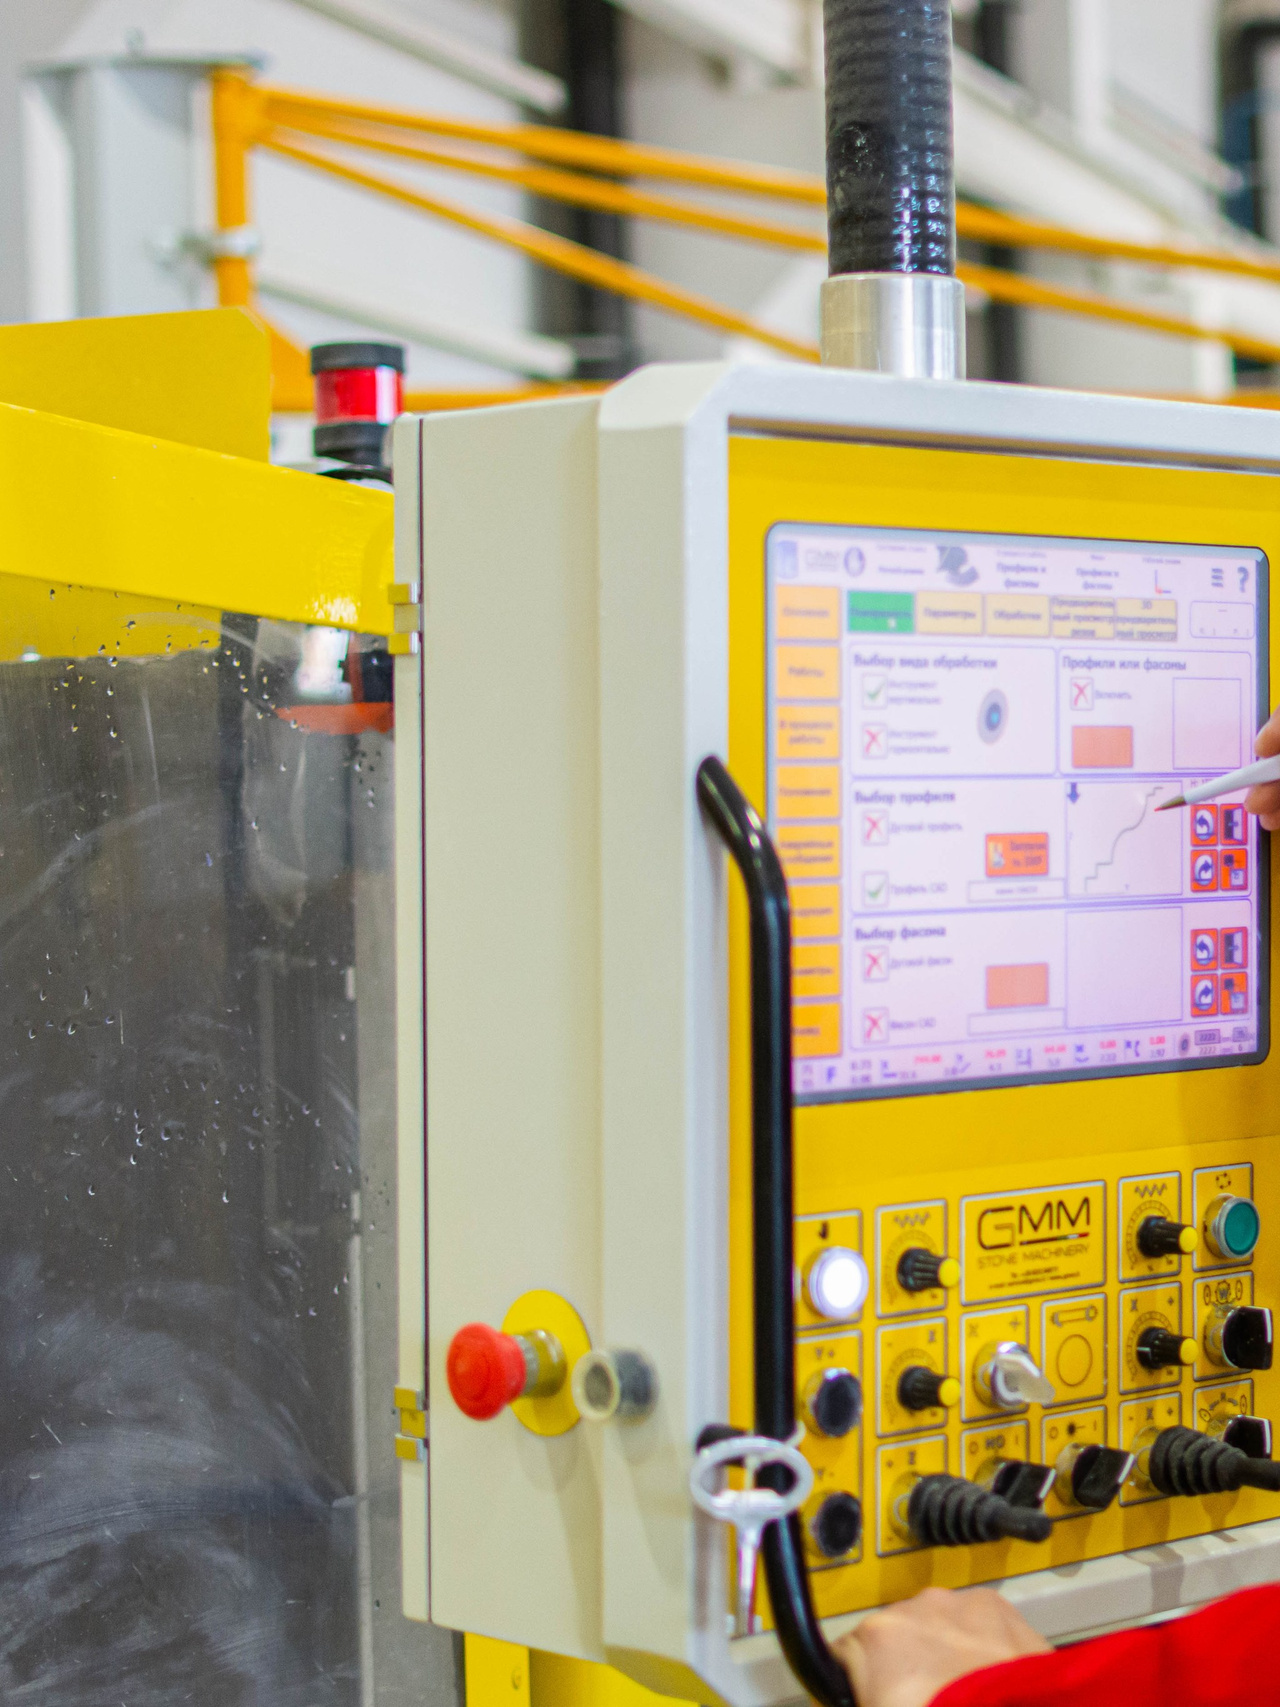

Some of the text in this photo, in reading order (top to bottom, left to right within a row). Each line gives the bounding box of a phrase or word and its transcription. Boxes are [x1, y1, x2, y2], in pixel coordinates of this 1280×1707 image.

[854, 654, 998, 671] Выбор вида обработки
[1062, 656, 1187, 673] Профили или фасоны
[855, 790, 956, 806] Выбор профиля
[855, 926, 946, 942] Выбор фасона
[977, 1197, 1090, 1250] GMM
[978, 1243, 1090, 1270] STONE MACHINERY
